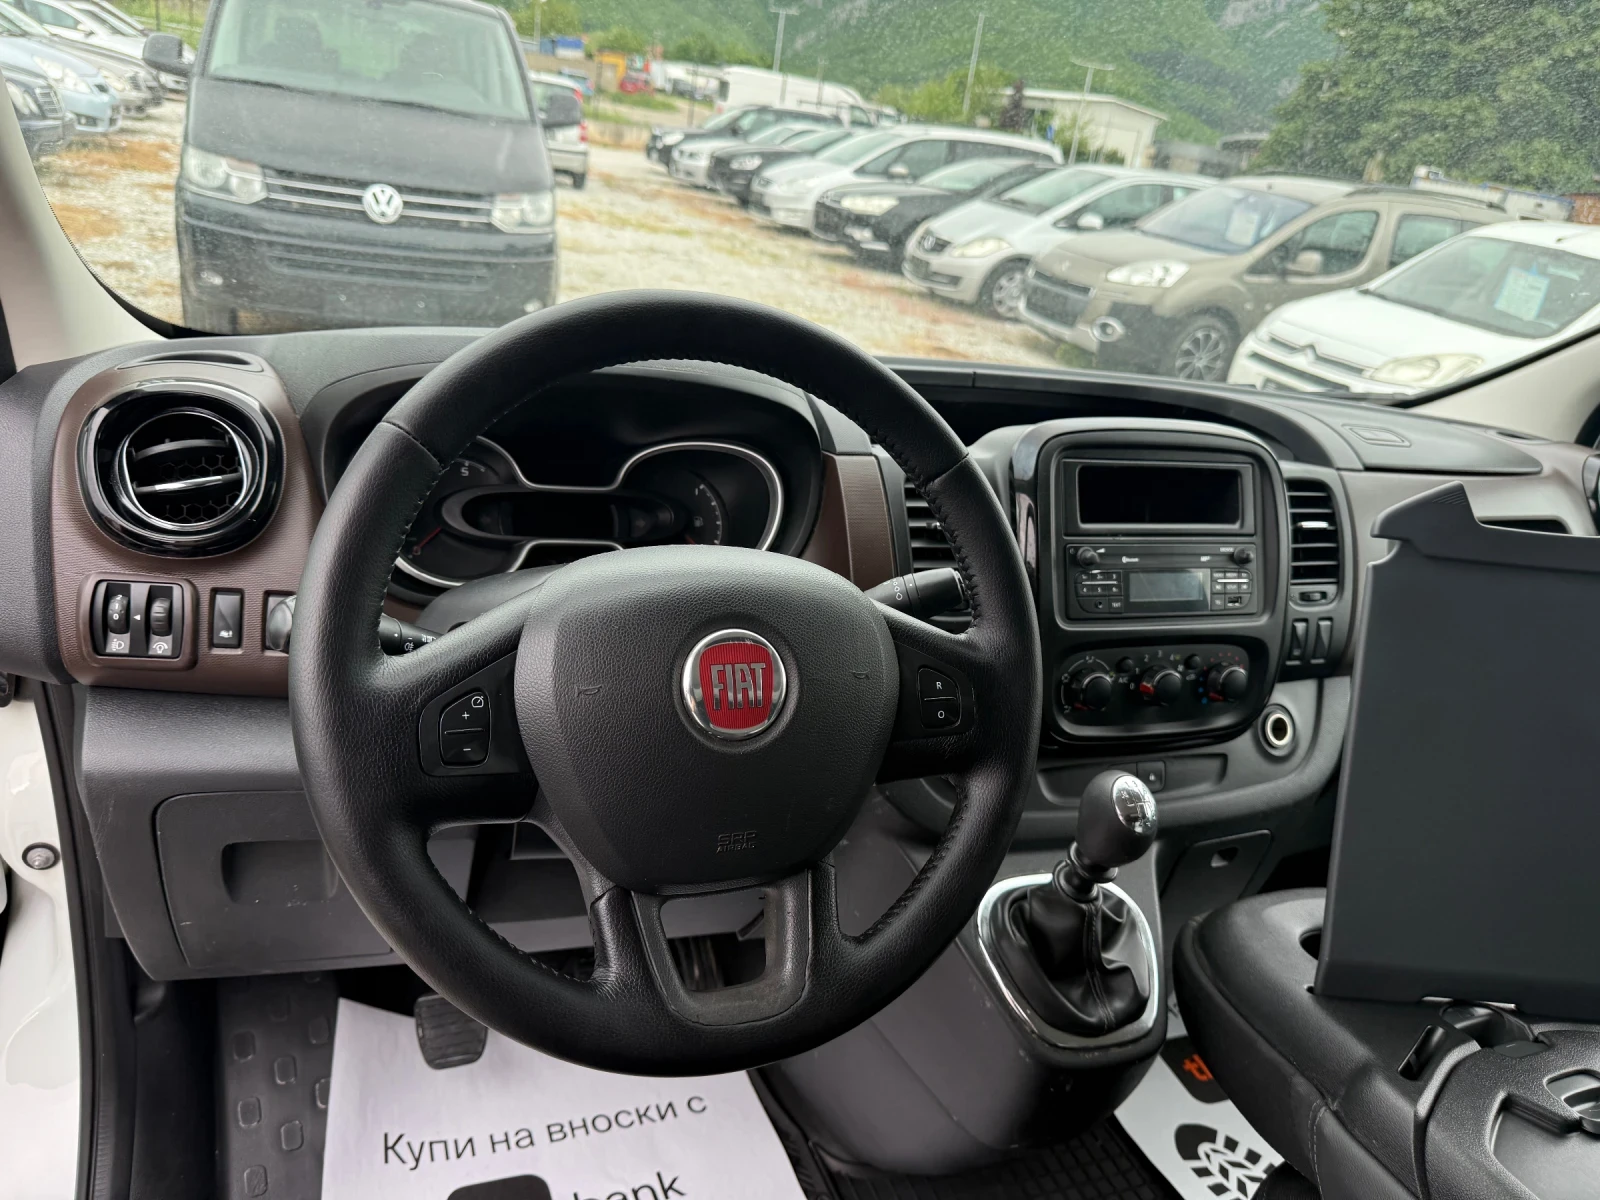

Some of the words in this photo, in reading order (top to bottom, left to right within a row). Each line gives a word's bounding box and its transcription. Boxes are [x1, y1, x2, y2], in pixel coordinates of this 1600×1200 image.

[362, 184, 404, 225] VW
[710, 662, 767, 711] FIAT
[935, 681, 943, 690] R
[383, 1131, 477, 1171] Купи
[489, 1127, 535, 1154] на
[546, 1101, 678, 1144] вноски
[687, 1095, 708, 1115] с
